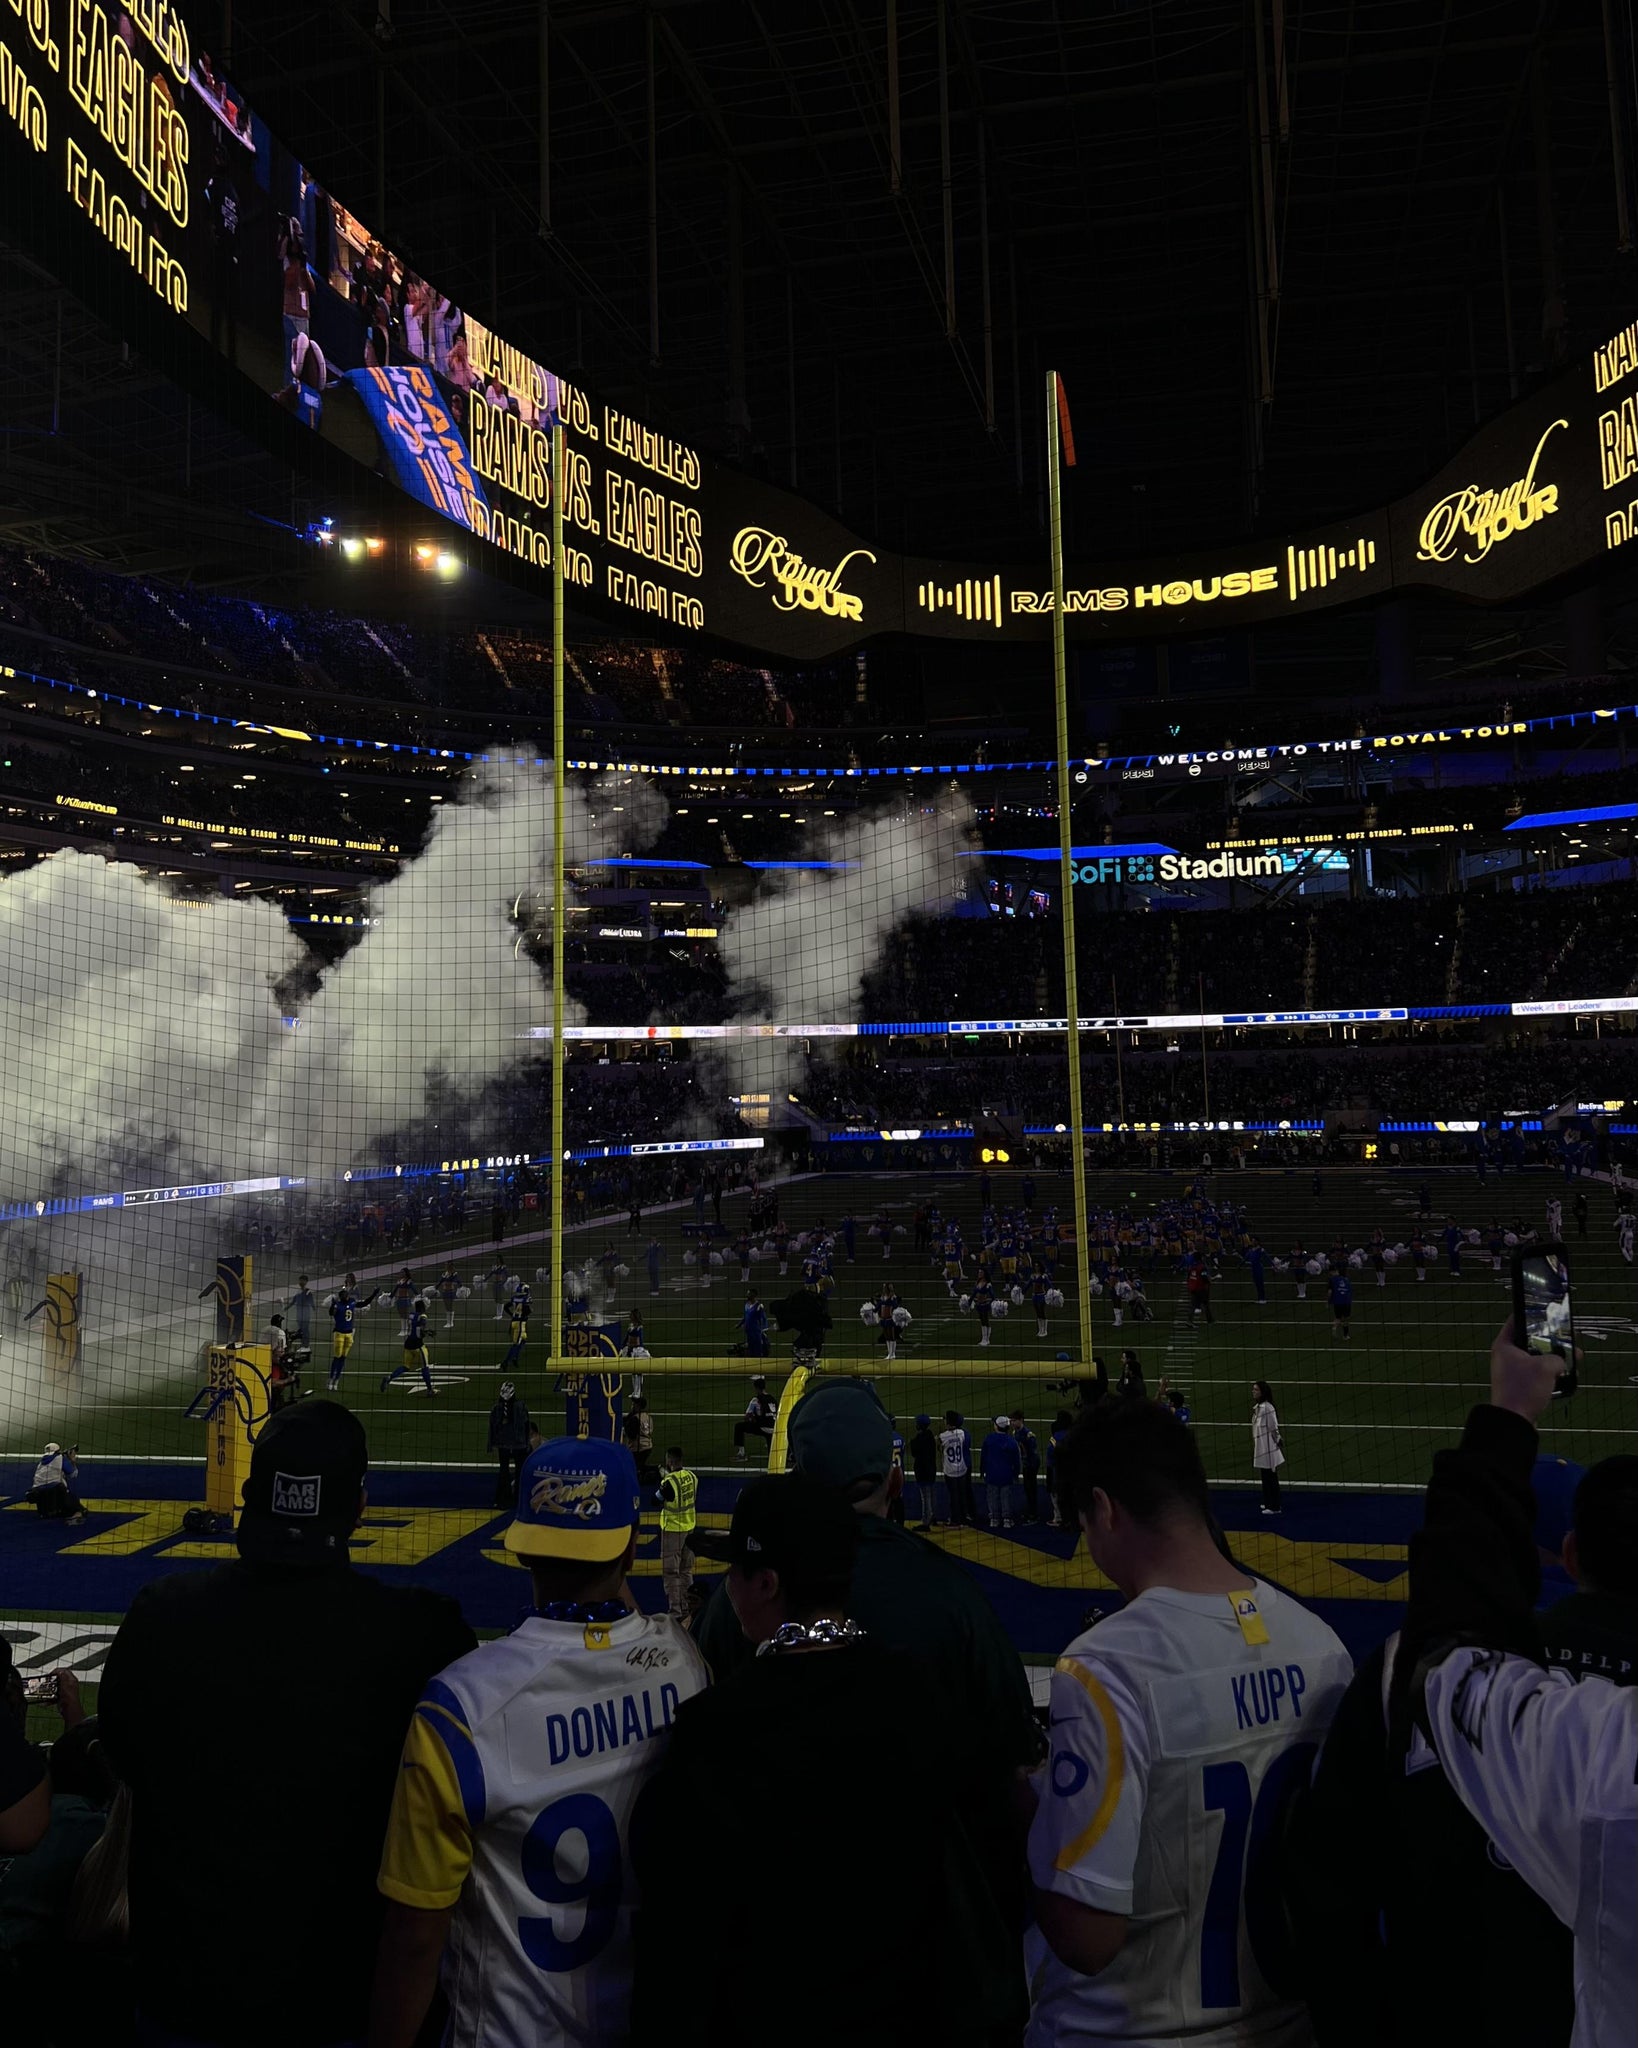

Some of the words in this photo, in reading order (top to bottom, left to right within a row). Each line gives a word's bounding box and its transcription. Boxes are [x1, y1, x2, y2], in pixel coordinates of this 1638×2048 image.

[69, 0, 189, 228] EAGLES
[469, 388, 550, 509] RAMS
[605, 469, 703, 578] EAGLES
[1416, 418, 1569, 564] Royal
[1469, 484, 1559, 550] TOUR
[729, 526, 877, 612] Royal
[777, 574, 864, 622] TOUR
[1011, 588, 1129, 613] RAMS
[1134, 566, 1278, 608] HOUSE
[1158, 747, 1268, 766] WELCOME
[1279, 744, 1307, 756] TO
[1319, 739, 1362, 753] THE
[1374, 731, 1452, 748] ROYAL
[1461, 722, 1527, 739] TOUR
[566, 760, 598, 770] LOS
[606, 763, 682, 774] ANGELES
[688, 767, 734, 775] RAMS
[1122, 769, 1154, 780] PEPSI
[1237, 760, 1270, 772] PEPSI
[162, 815, 175, 825] LOS
[206, 823, 225, 833] RAMS
[251, 829, 278, 840] SEASON
[389, 845, 400, 853] CA
[1206, 841, 1221, 849] LOS
[1304, 834, 1334, 843] SEASON
[1463, 823, 1475, 831] CA
[1069, 857, 1121, 885] SoFi
[1160, 850, 1283, 881] Stadium
[310, 913, 354, 924] RAMS
[1103, 1122, 1161, 1132] RAMS
[1173, 1121, 1245, 1131] HOUSE
[441, 1158, 480, 1172] RAMS
[93, 1196, 114, 1207] RAMS
[946, 1445, 962, 1463] 99
[276, 1480, 316, 1496] LAR
[276, 1495, 316, 1510] AMS
[1231, 1664, 1307, 1731] KUPP
[545, 1682, 679, 1766] DONALD
[517, 1792, 622, 1974] 9
